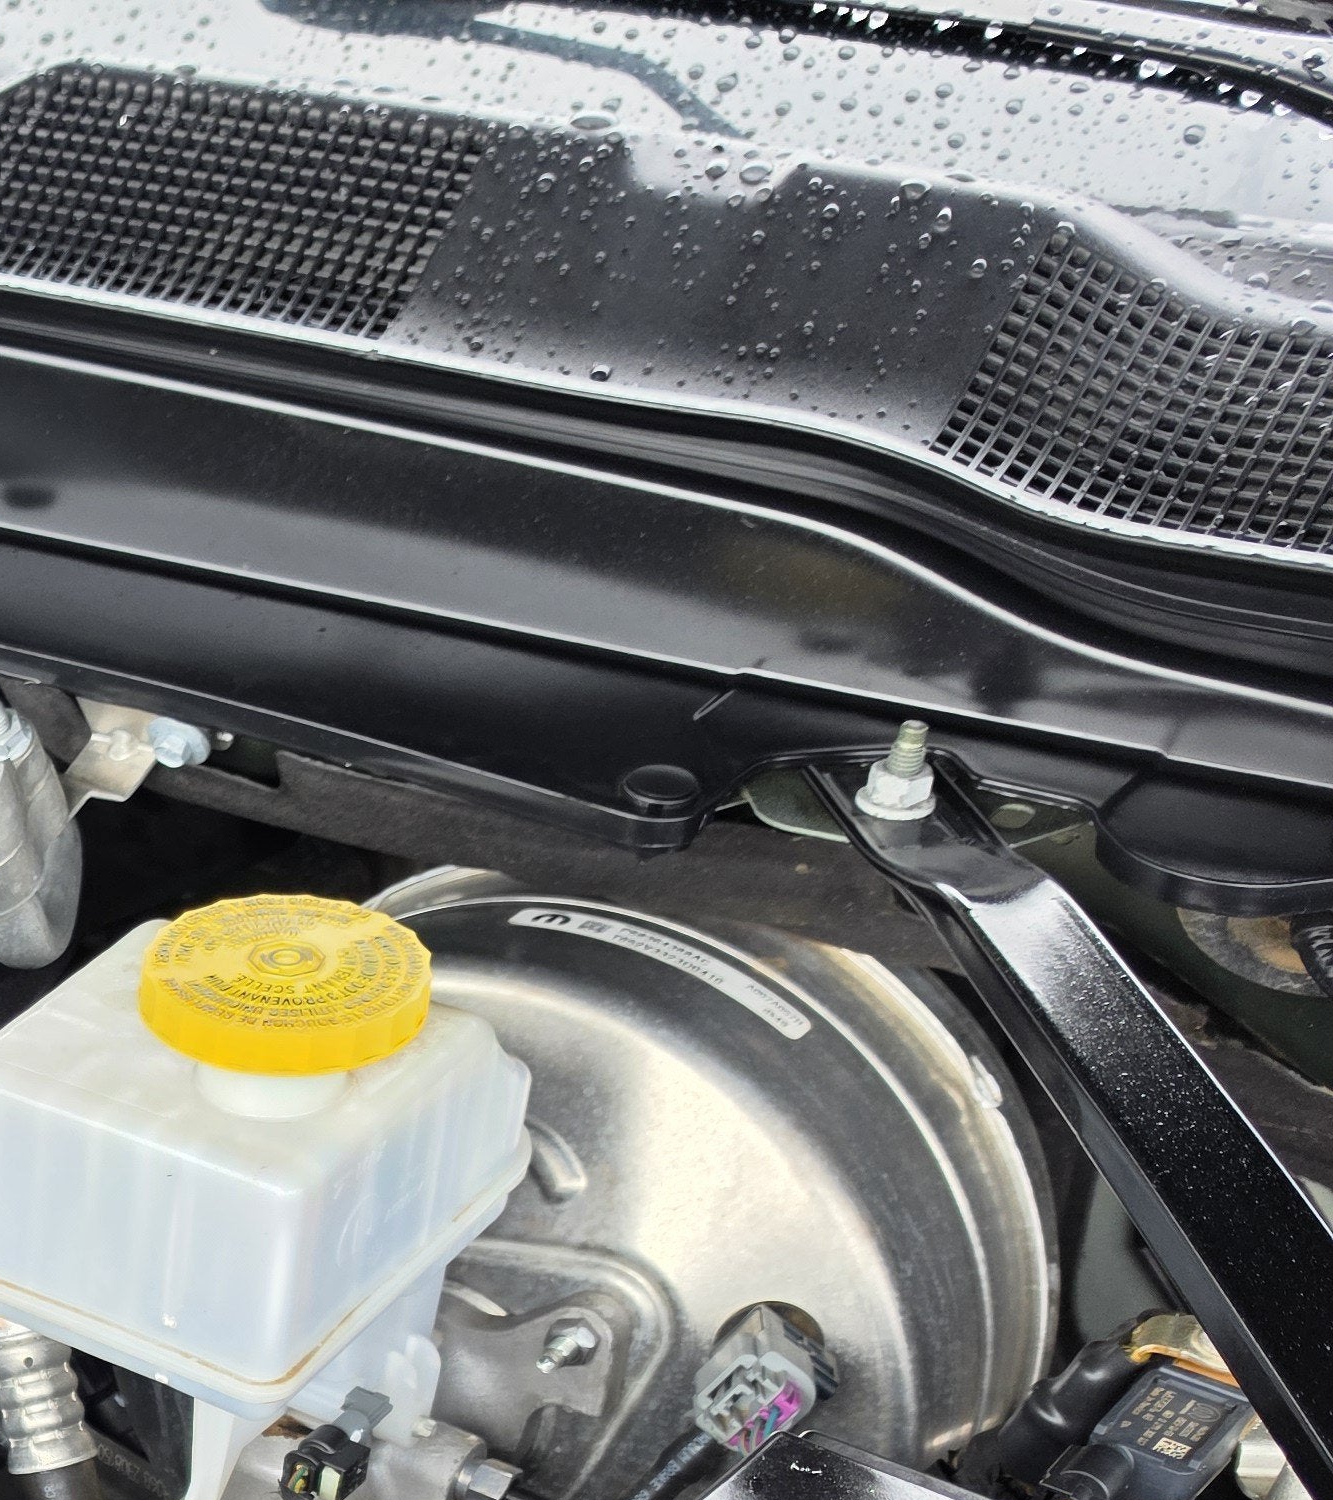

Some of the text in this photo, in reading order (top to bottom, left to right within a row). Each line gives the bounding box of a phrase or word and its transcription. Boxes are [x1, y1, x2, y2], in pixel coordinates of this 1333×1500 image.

[240, 896, 285, 909] FROM
[287, 896, 332, 909] FLUID
[333, 980, 368, 998] DOT
[223, 987, 329, 1008] PROVENANT
[265, 1002, 340, 1019] UTILISER
[258, 1014, 342, 1030] BOUCHON
